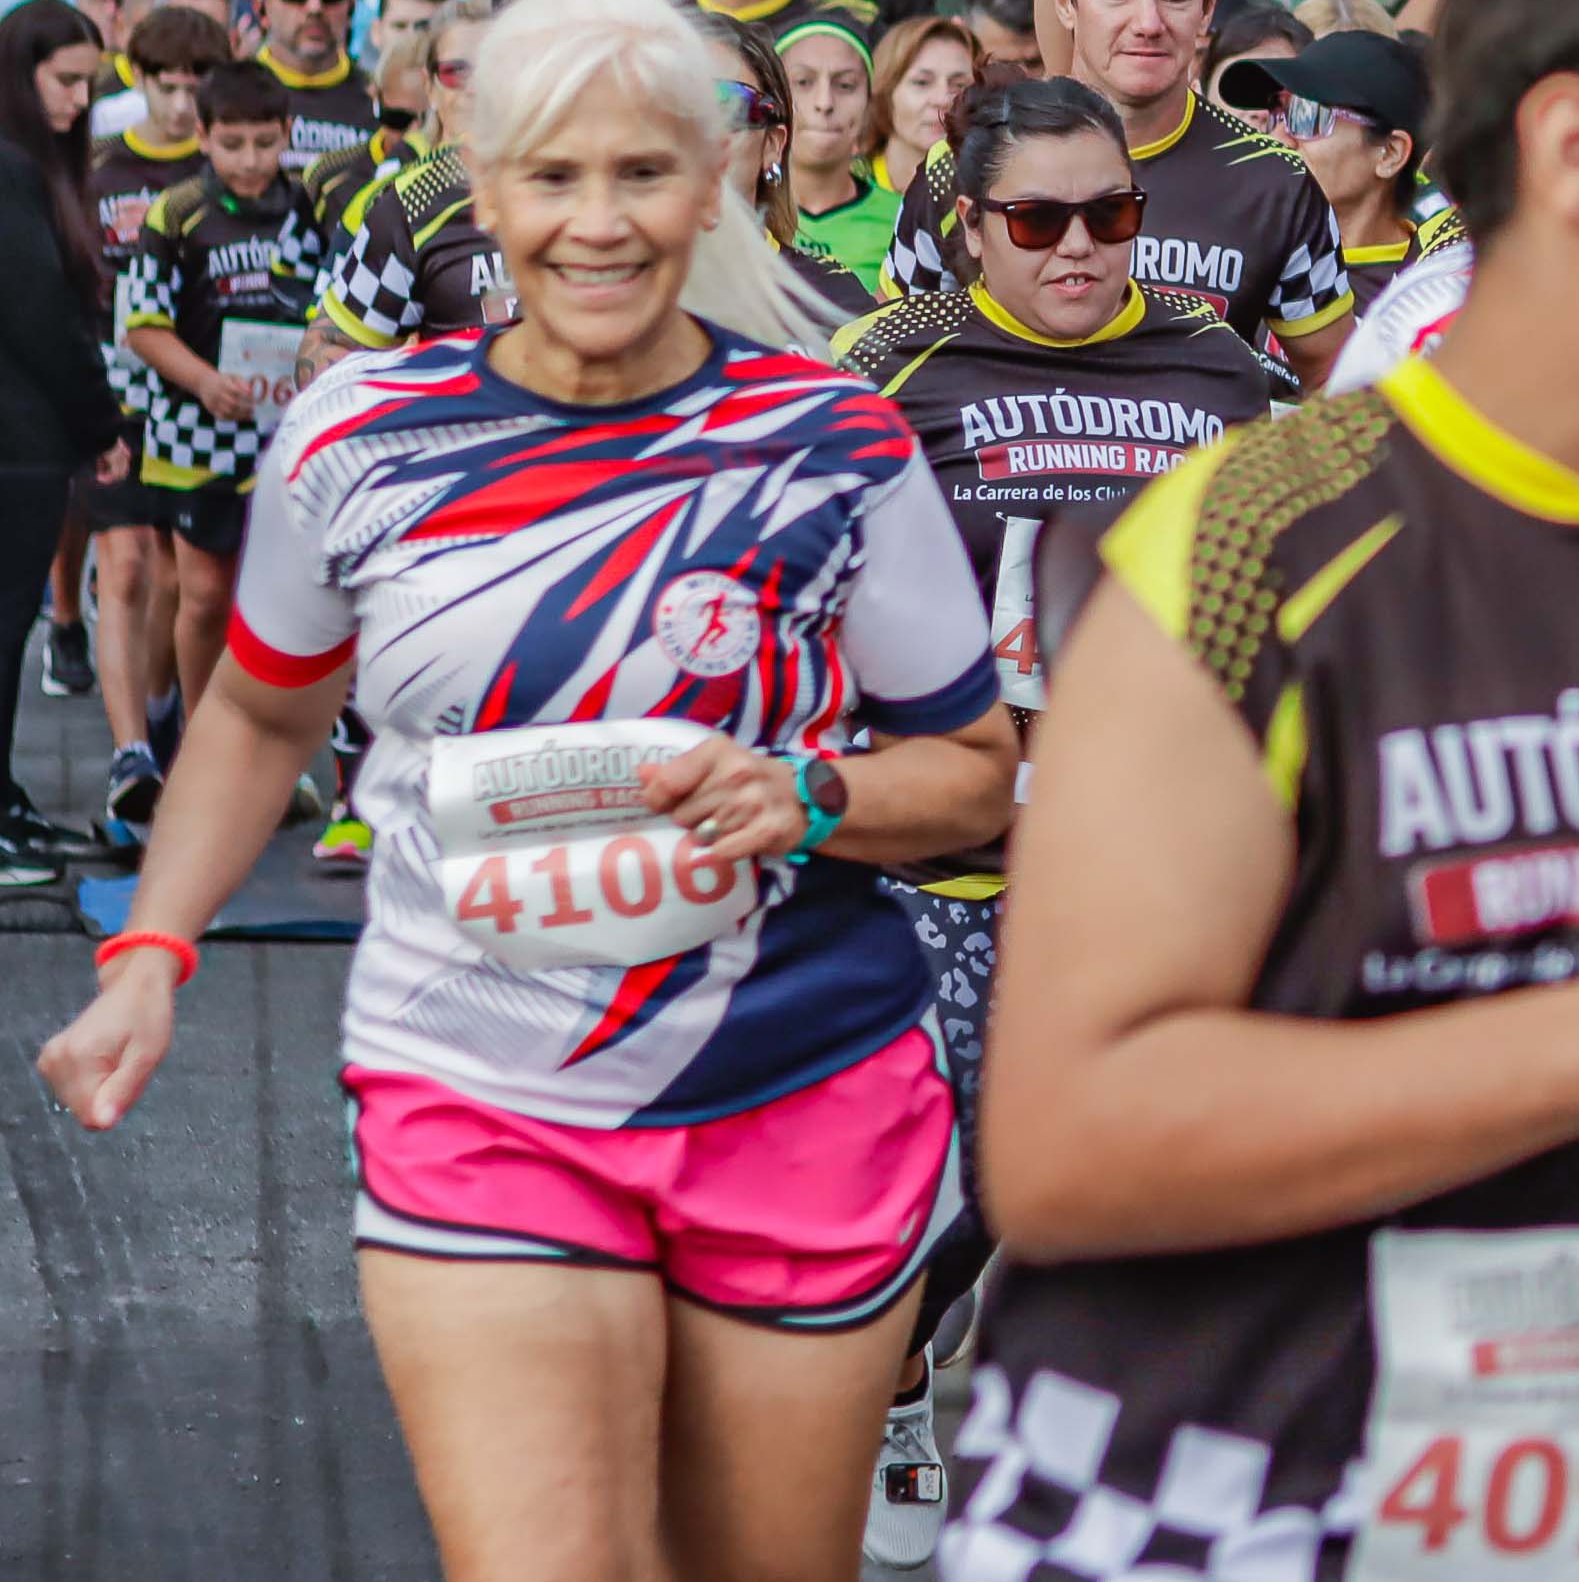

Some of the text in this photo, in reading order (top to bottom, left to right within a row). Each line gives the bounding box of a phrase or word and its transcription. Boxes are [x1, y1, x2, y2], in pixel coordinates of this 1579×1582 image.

[960, 388, 1224, 450] AUTÓDROMO
[1007, 444, 1127, 474] RUNNING
[954, 484, 972, 501] La
[975, 485, 1039, 502] Carrera
[1043, 484, 1064, 501] de
[1068, 485, 1091, 502] los
[456, 830, 738, 935] 4106
